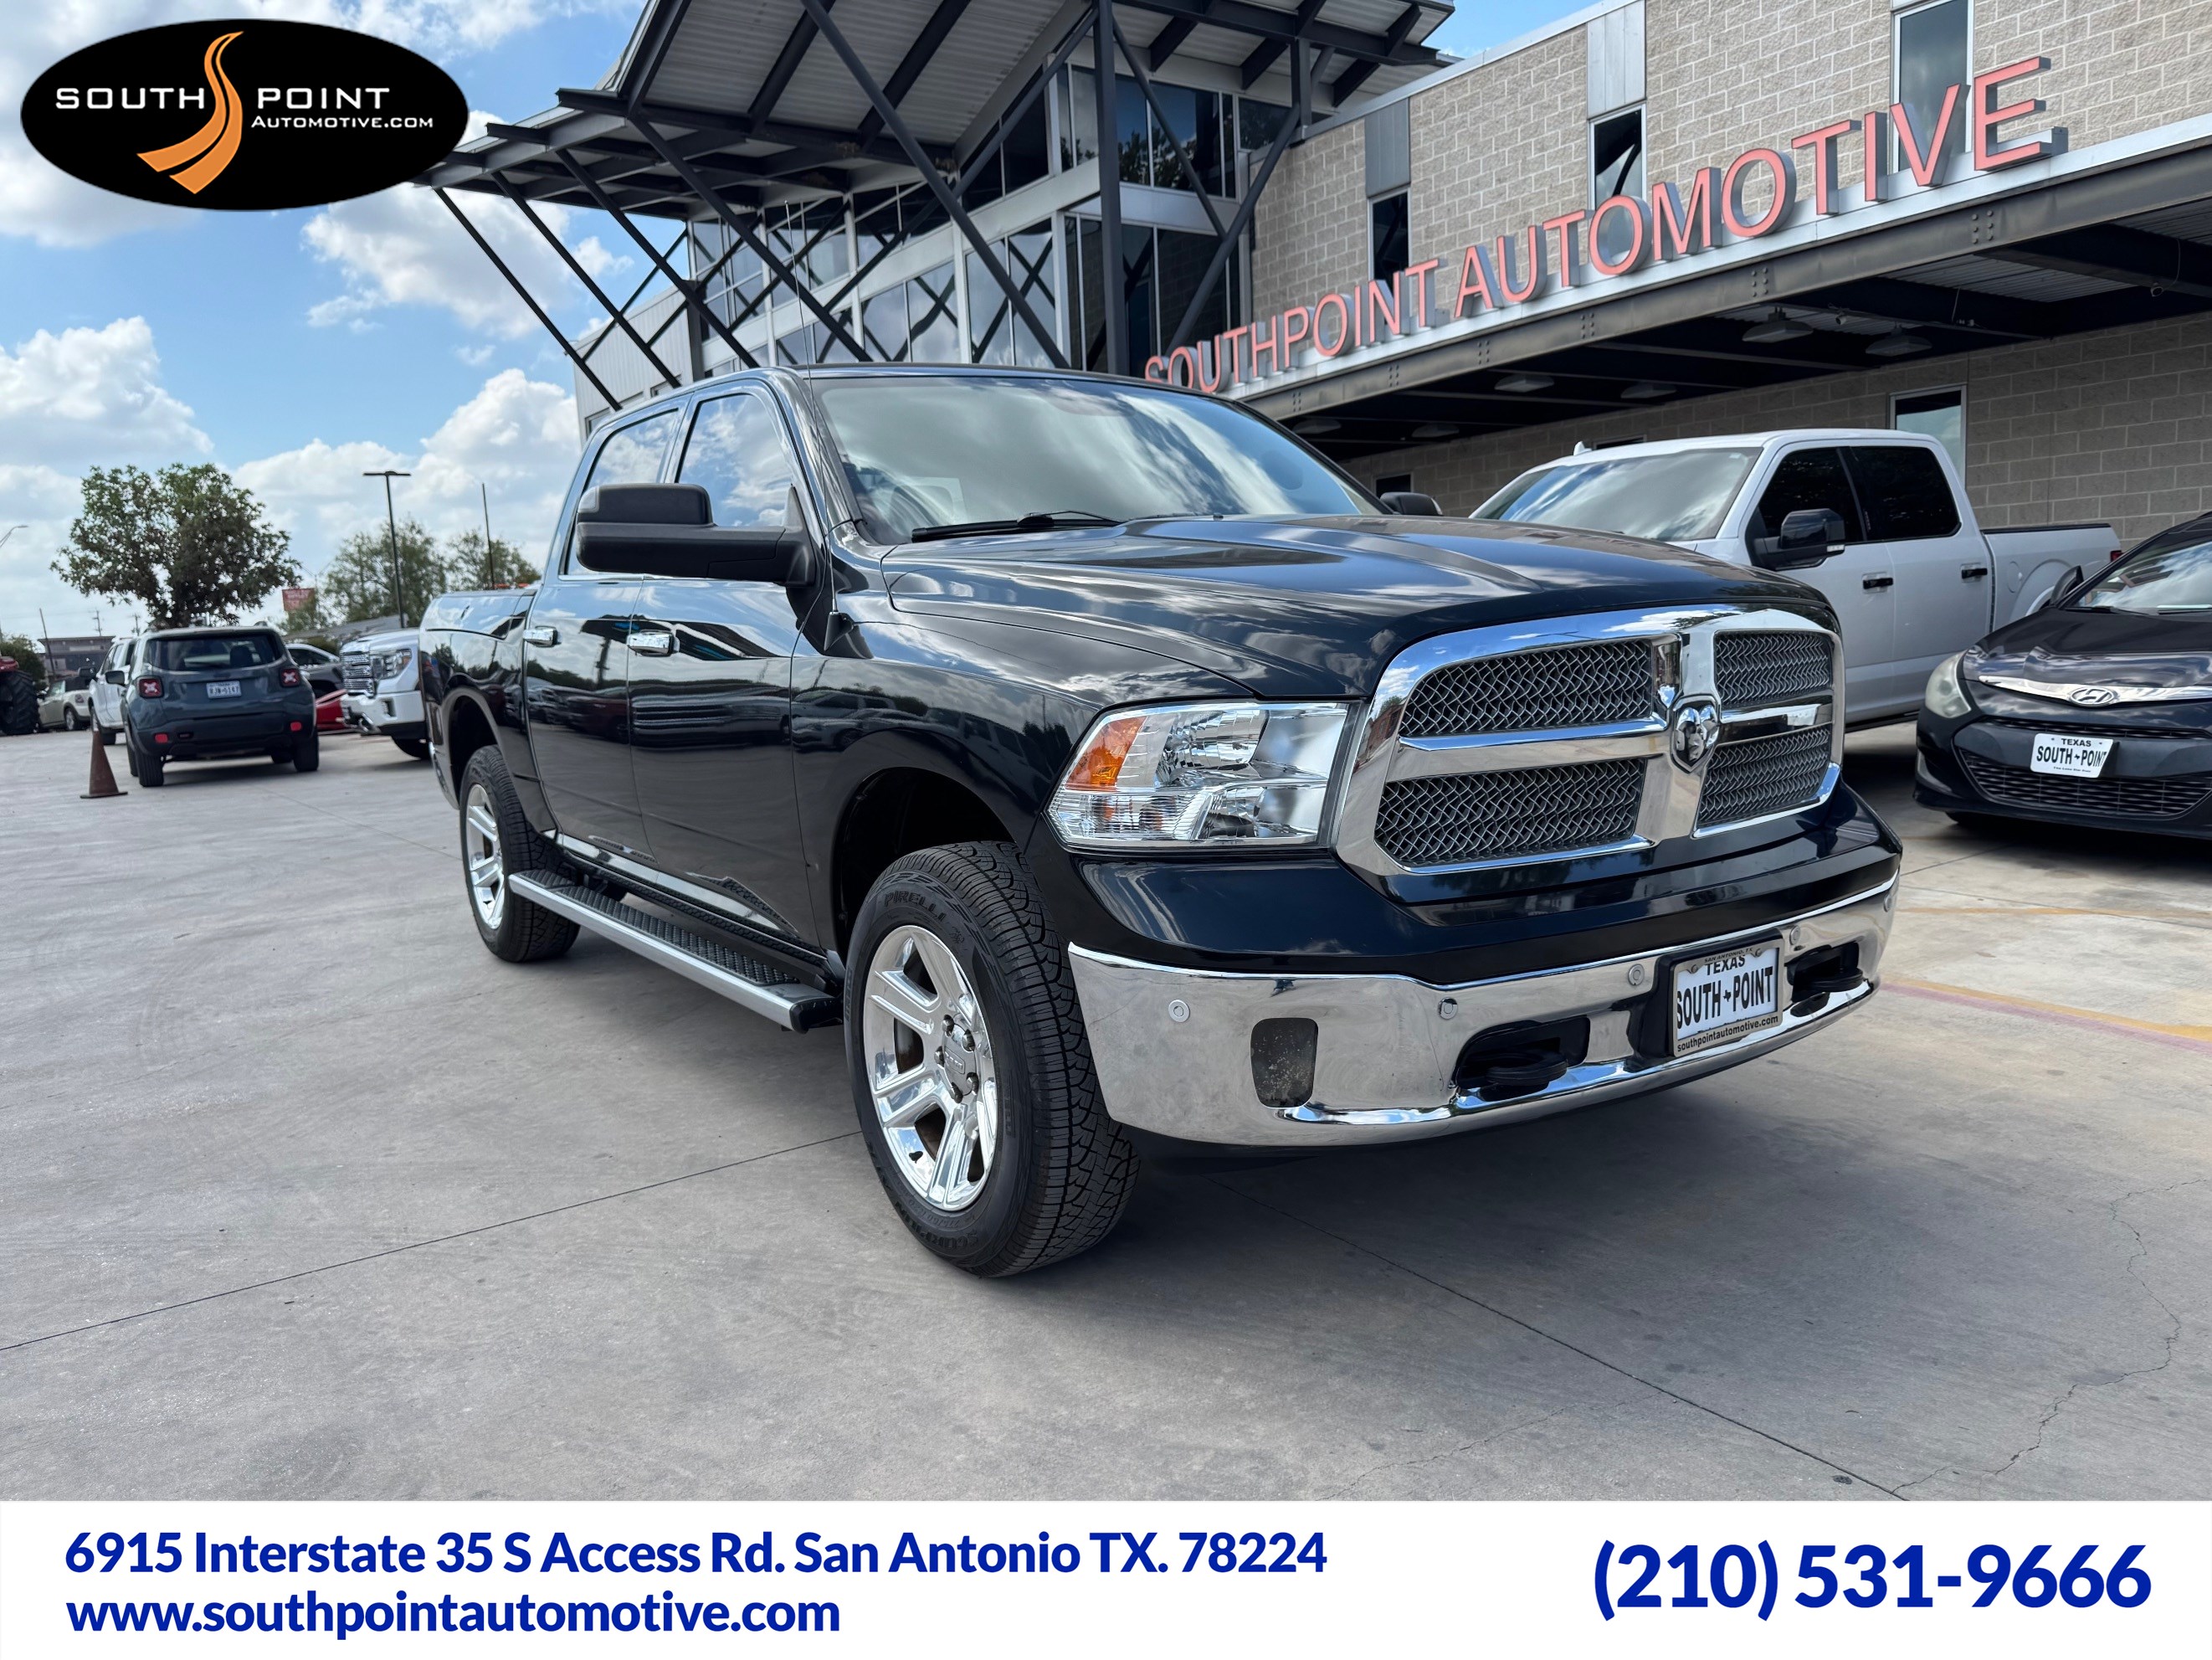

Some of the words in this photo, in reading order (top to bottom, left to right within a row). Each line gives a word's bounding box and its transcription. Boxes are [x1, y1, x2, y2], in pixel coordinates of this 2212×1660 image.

[1144, 259, 1443, 393] SOUTHPOINT
[1455, 56, 2052, 318] AUTOMOTIVE
[2036, 746, 2073, 765] SOUTH
[2081, 749, 2107, 768] POINT
[2061, 738, 2091, 748] TEXAS
[884, 890, 947, 923] PIRELLI
[1706, 954, 1746, 976] TEXAS
[1676, 980, 1722, 1030] SOUTH
[1732, 966, 1773, 1012] POINT
[1677, 1015, 1778, 1052] southpointautomotive.com
